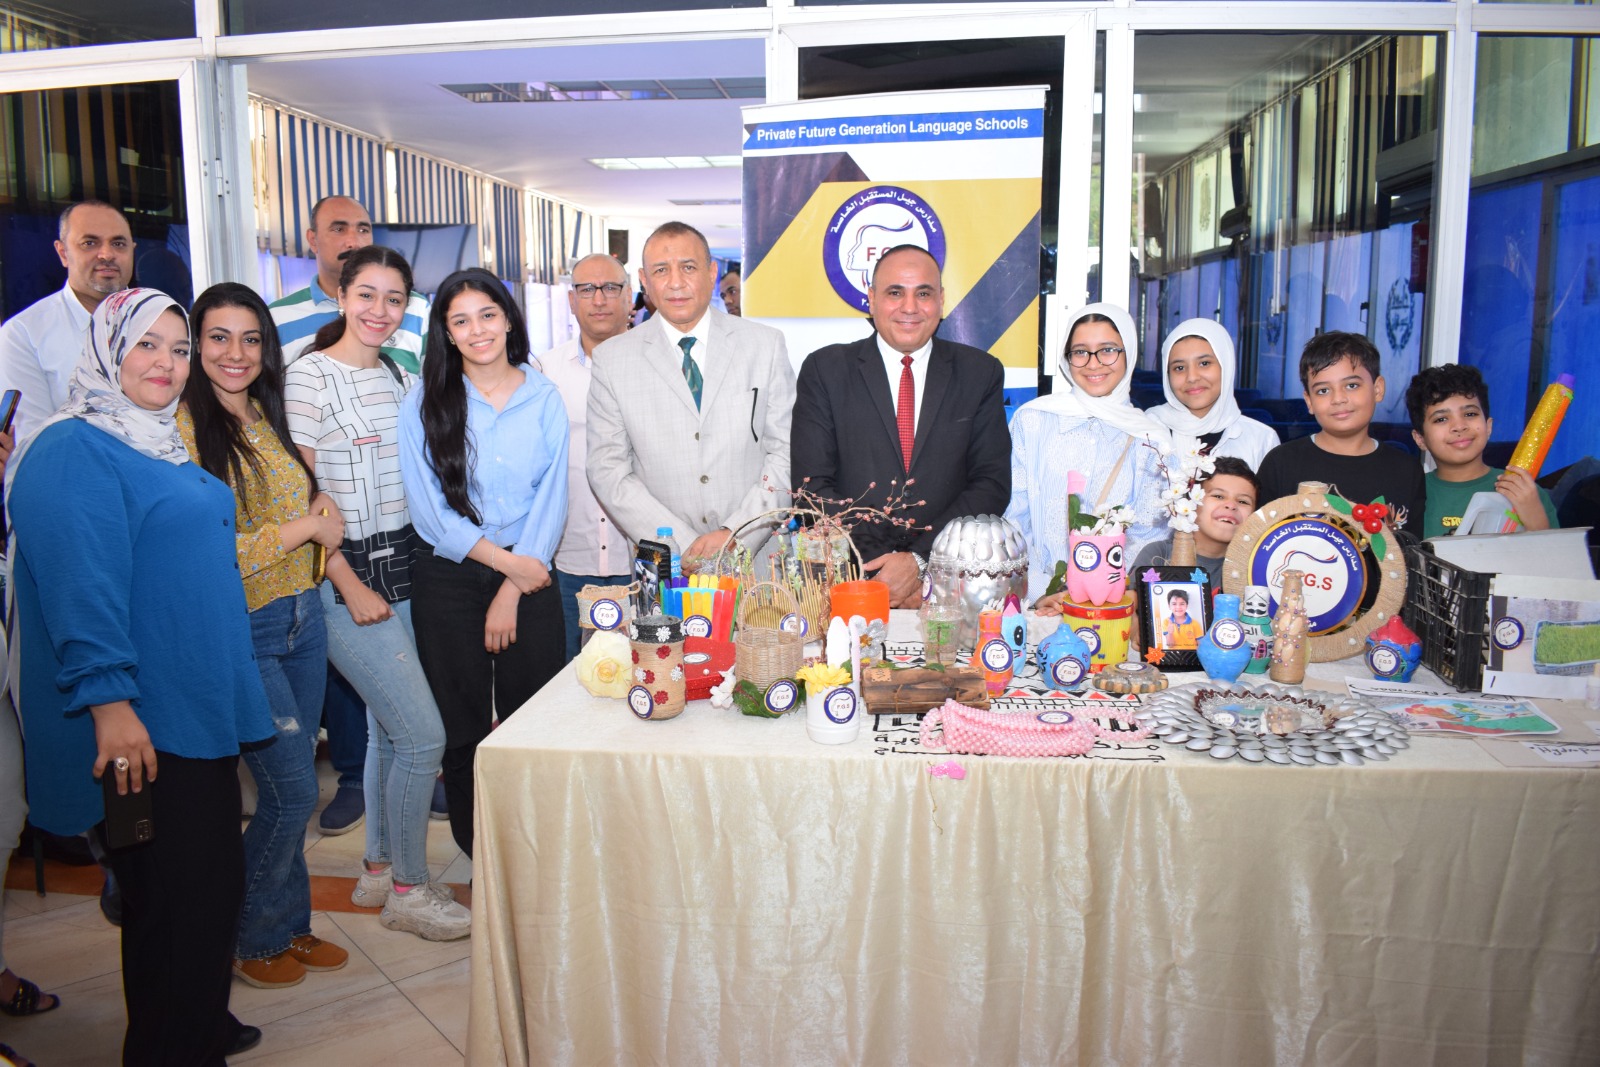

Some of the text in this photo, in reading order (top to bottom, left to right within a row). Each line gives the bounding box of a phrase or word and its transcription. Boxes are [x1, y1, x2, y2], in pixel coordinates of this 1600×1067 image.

[757, 116, 1029, 141] Private Future Generation Language Schools
[859, 190, 897, 206] المستقبل
[830, 200, 858, 233] الخاصة
[915, 206, 937, 233] مدارس
[1262, 527, 1291, 552] الخاصة
[1292, 523, 1329, 534] المستقبل
